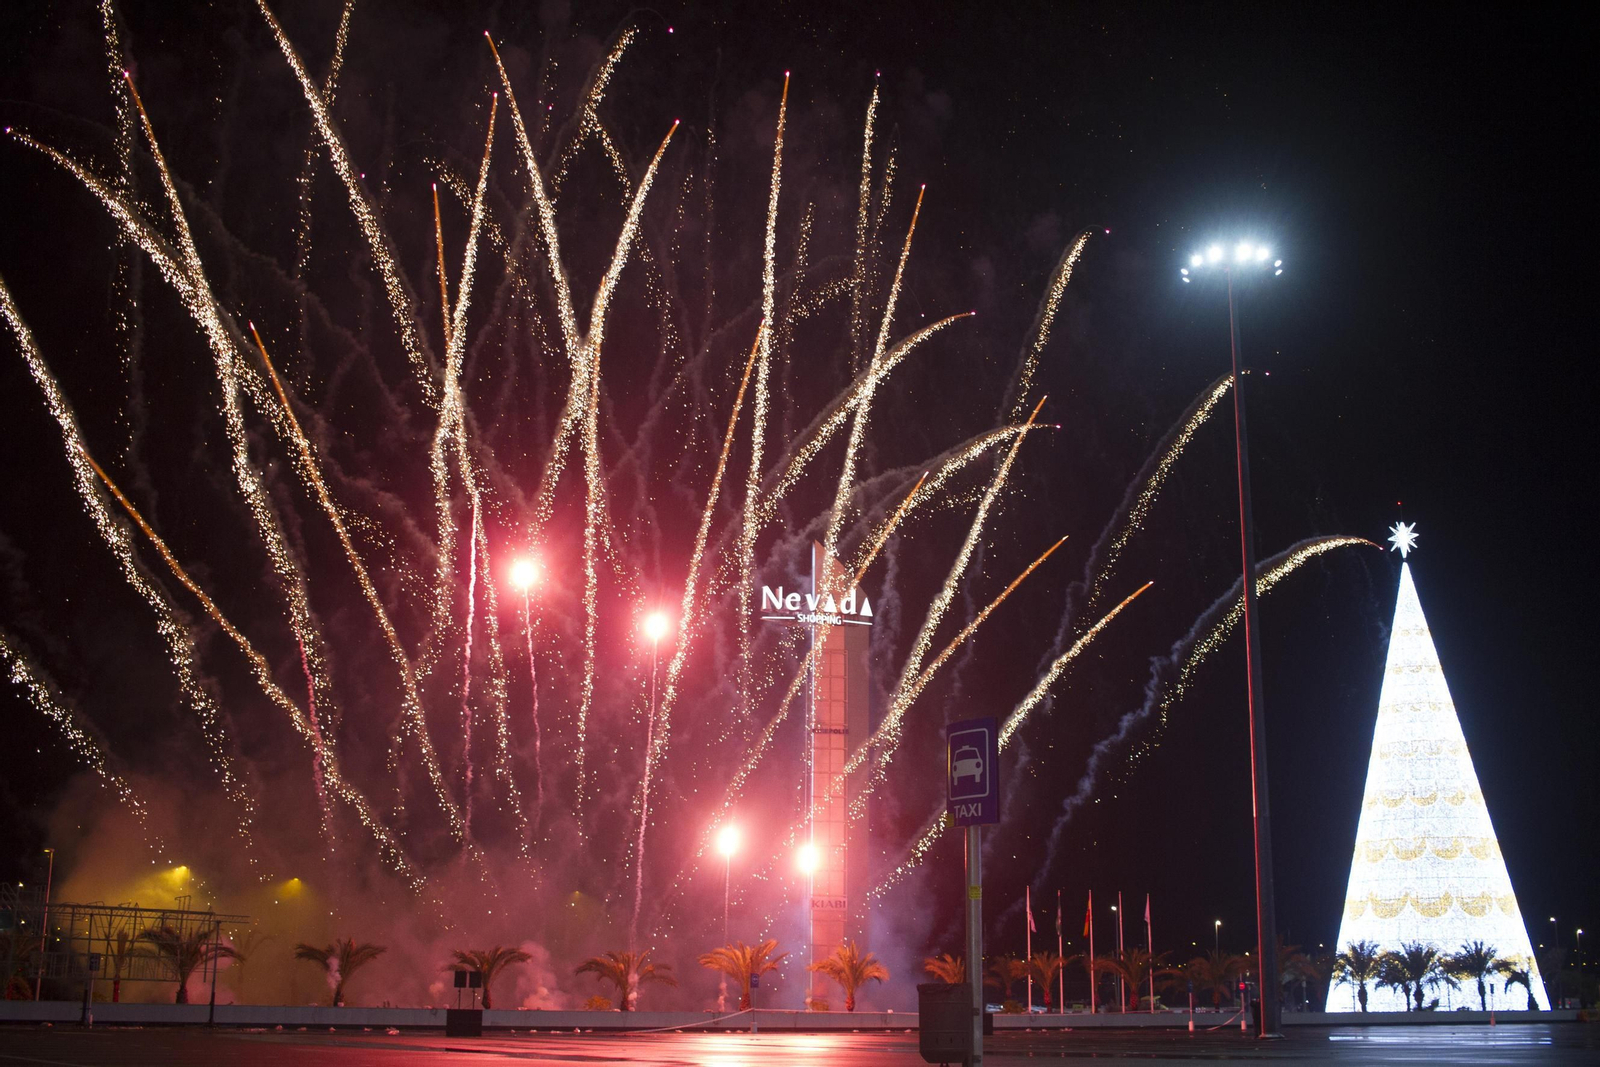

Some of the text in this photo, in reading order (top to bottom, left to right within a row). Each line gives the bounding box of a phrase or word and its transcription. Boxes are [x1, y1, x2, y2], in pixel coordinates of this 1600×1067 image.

[797, 613, 842, 625] SHOPPING
[953, 803, 982, 818] TAXI
[811, 900, 846, 908] KIABI
